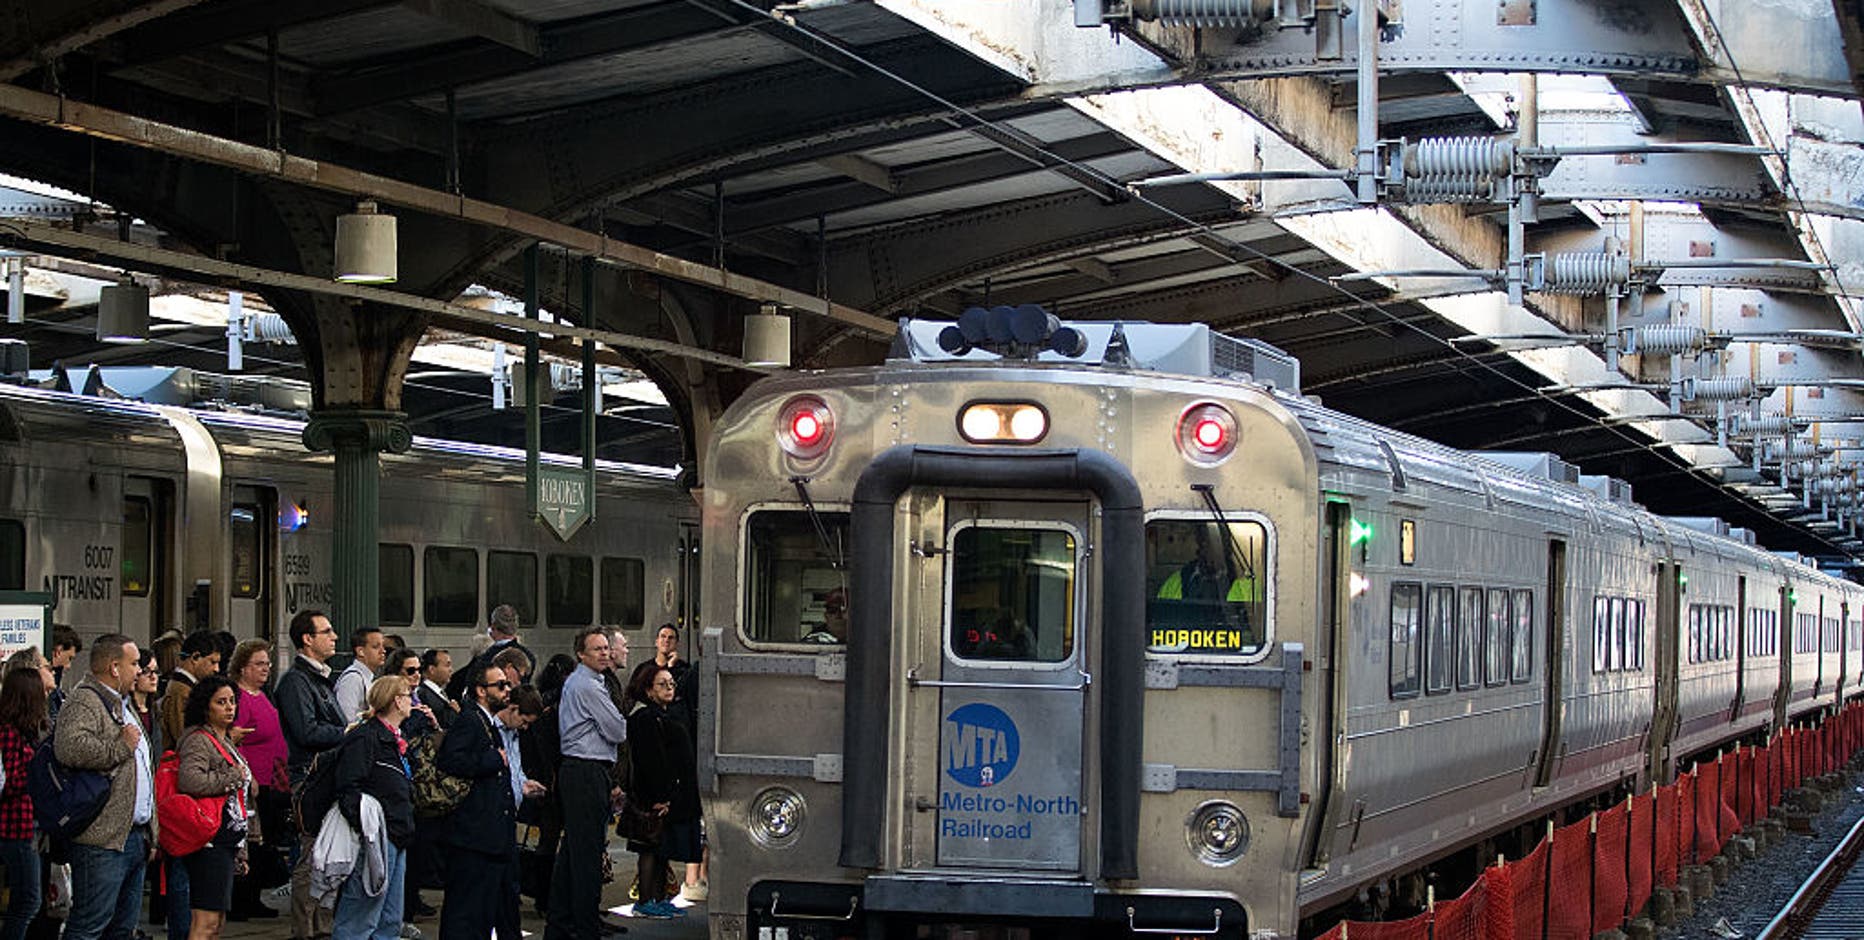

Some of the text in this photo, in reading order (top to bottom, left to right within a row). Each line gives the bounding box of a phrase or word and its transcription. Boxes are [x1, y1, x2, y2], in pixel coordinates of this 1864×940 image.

[85, 545, 114, 569] 6007
[1152, 630, 1241, 648] HOBOKEN
[945, 721, 1008, 770] MTA
[943, 792, 1079, 815] Metro-North
[942, 818, 1032, 839] Railroad
